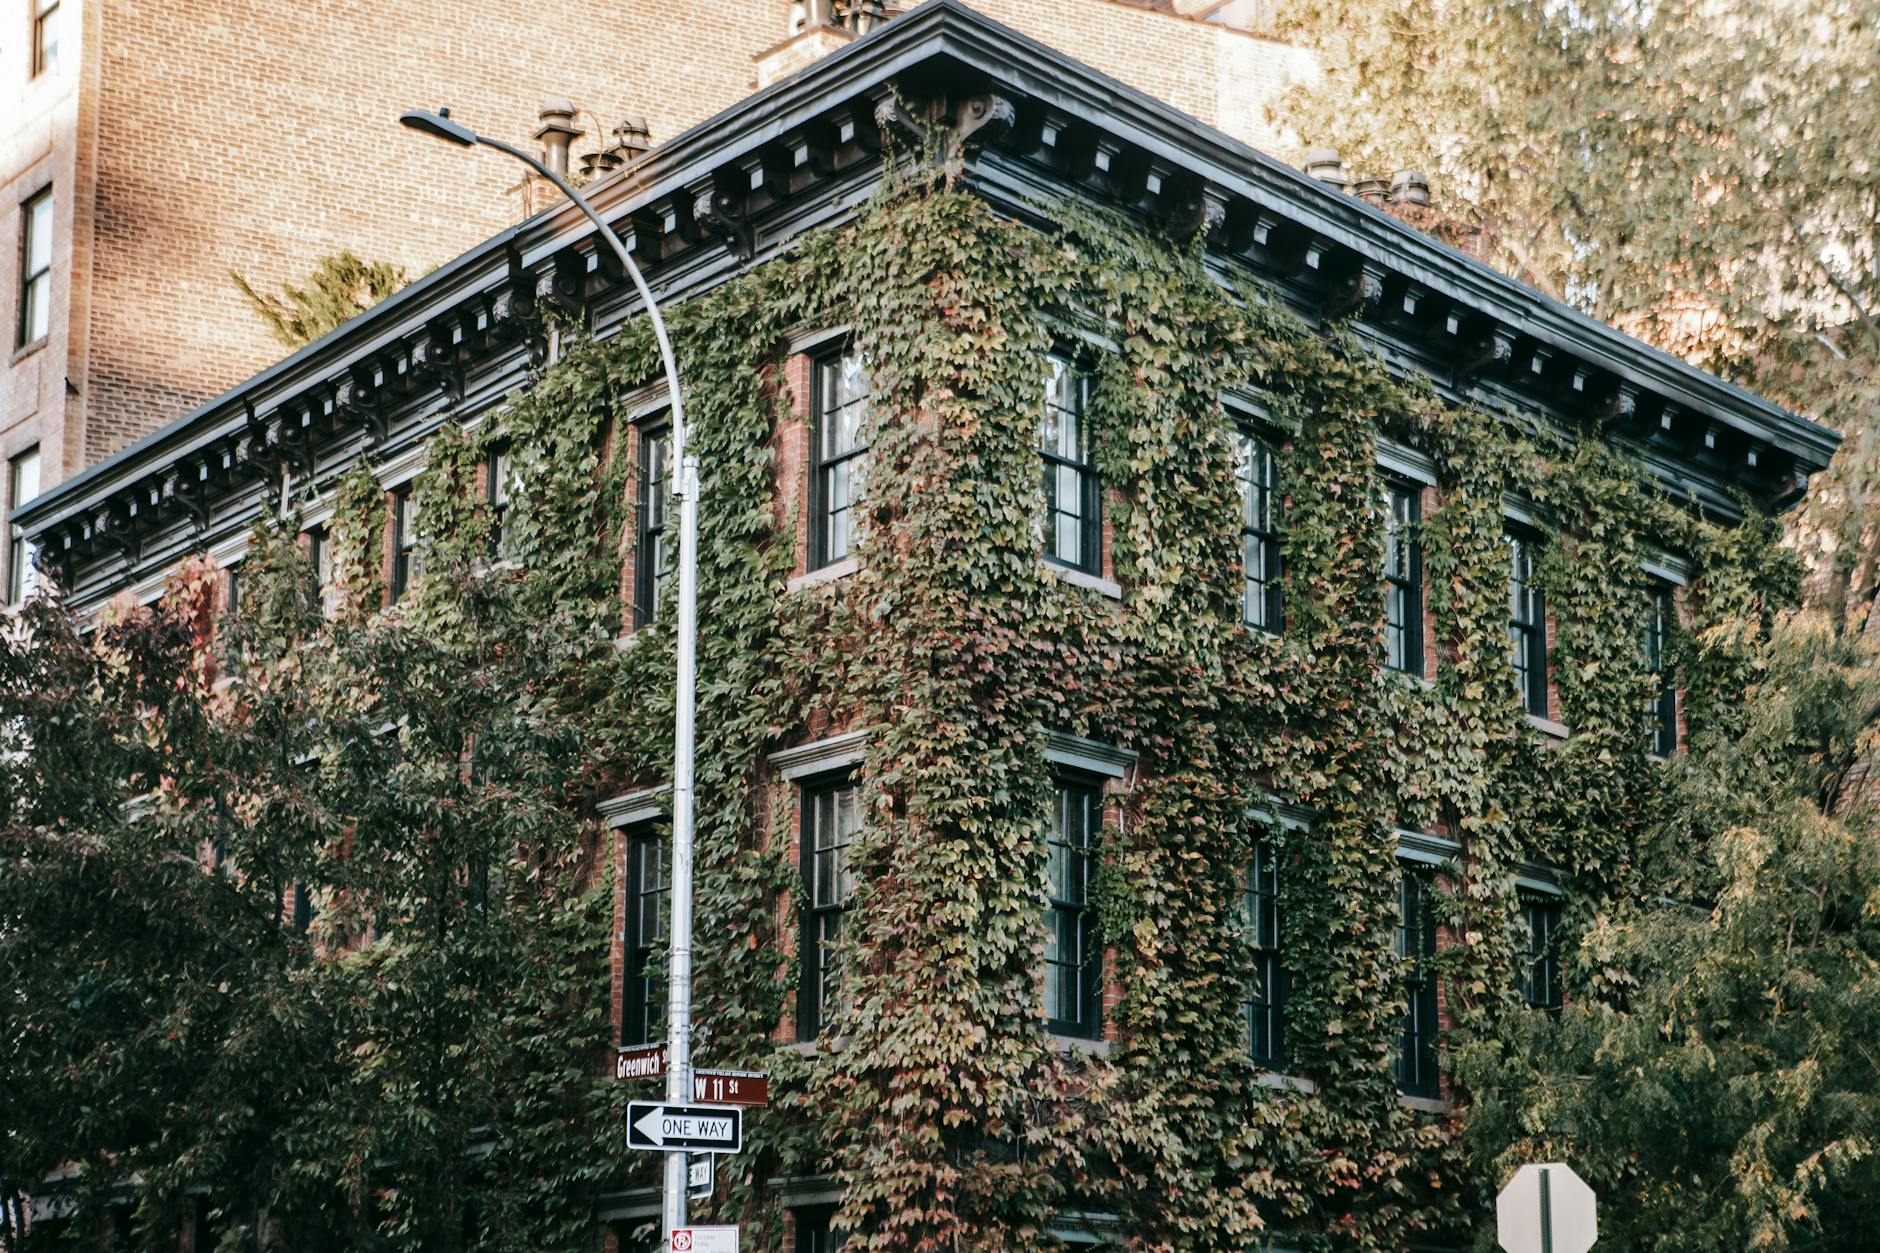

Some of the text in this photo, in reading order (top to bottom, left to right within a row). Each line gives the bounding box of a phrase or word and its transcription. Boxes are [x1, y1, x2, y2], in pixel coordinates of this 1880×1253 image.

[617, 1052, 660, 1079] Greenwich
[695, 1078, 739, 1100] W 11 St
[662, 1118, 728, 1137] ONE WAY
[695, 1164, 708, 1181] WAY
